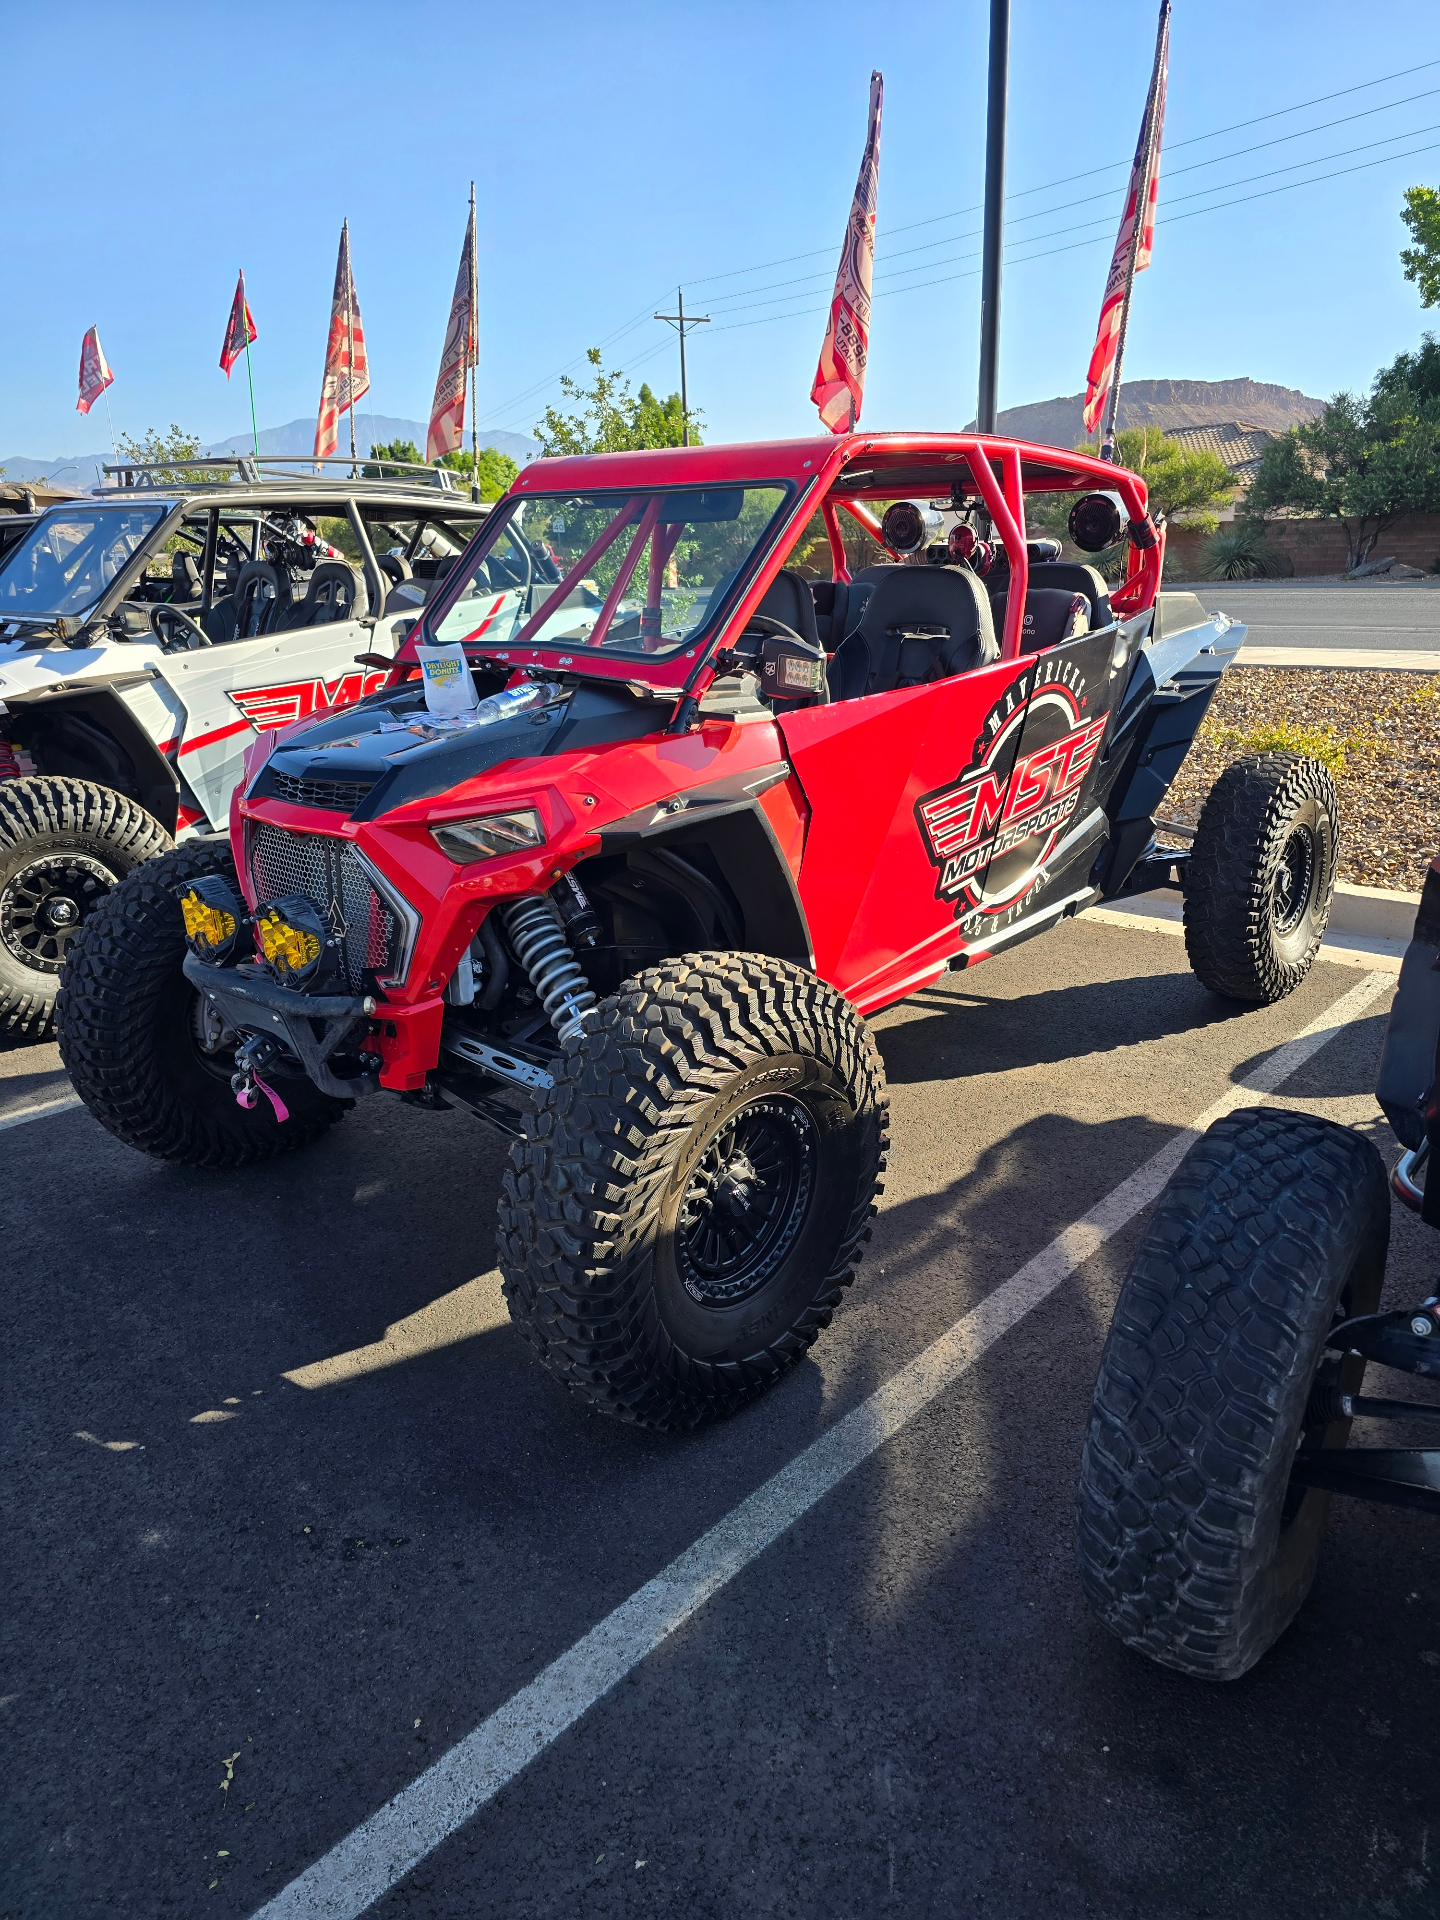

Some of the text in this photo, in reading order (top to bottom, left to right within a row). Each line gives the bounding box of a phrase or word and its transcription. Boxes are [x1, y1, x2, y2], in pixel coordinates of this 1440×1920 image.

[836, 336, 854, 364] UTAH
[425, 660, 460, 670] DAYLIGHT
[429, 668, 460, 676] DONUTS
[988, 660, 1087, 733] MAVERICKS
[962, 727, 1092, 845] MST
[942, 790, 1078, 888] MOTORSPORTS
